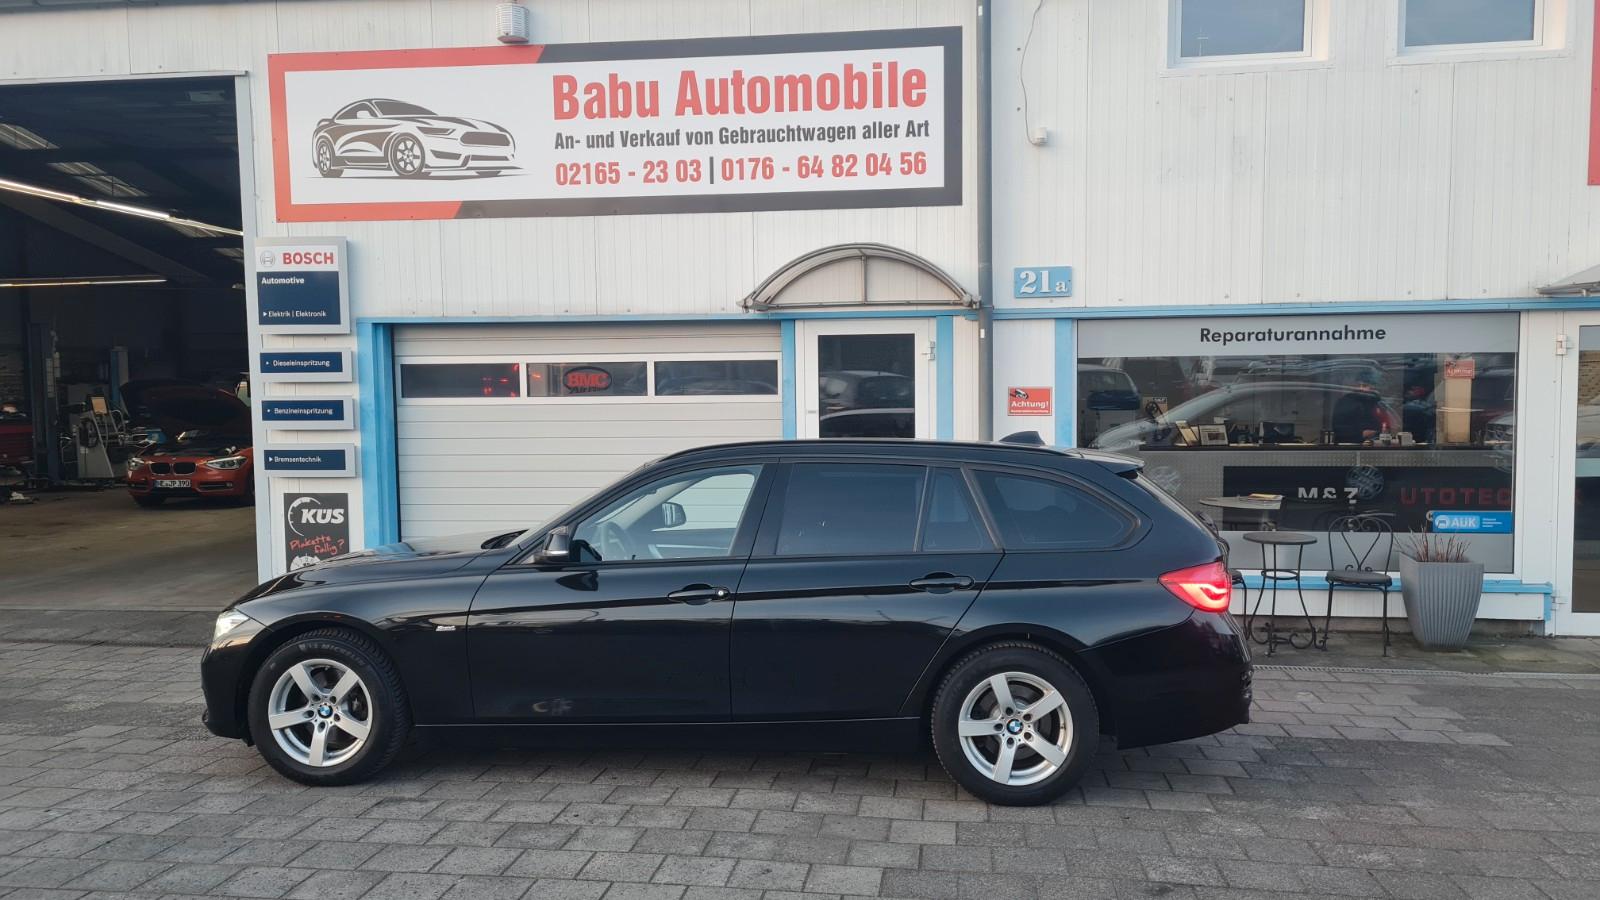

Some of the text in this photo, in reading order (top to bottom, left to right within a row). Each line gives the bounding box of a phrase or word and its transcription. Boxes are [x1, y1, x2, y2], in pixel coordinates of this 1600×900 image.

[553, 62, 927, 120] Babu Automobile
[555, 119, 930, 150] An- und Verkauf von Gebrauchtwagen aller Art
[556, 162, 621, 186] 02165
[644, 160, 669, 184] 23
[676, 159, 702, 183] 03
[722, 157, 775, 181] 0176
[798, 155, 824, 179] 64
[832, 154, 858, 178] 82
[866, 152, 893, 177] 04
[900, 151, 927, 176] 56
[282, 252, 334, 265] BOSCH
[261, 277, 305, 285] Automotive
[1019, 270, 1068, 294] 21a
[1200, 325, 1387, 346] Reparaturannahme
[272, 359, 331, 368] Dieseleinspritzung
[567, 372, 609, 388] BMC
[274, 407, 333, 416] Benzineinspritzung
[1011, 400, 1049, 409] Achtung!
[274, 455, 322, 464] Bremsentechnik
[301, 508, 345, 524] KÜS
[1451, 517, 1477, 528] AUK
